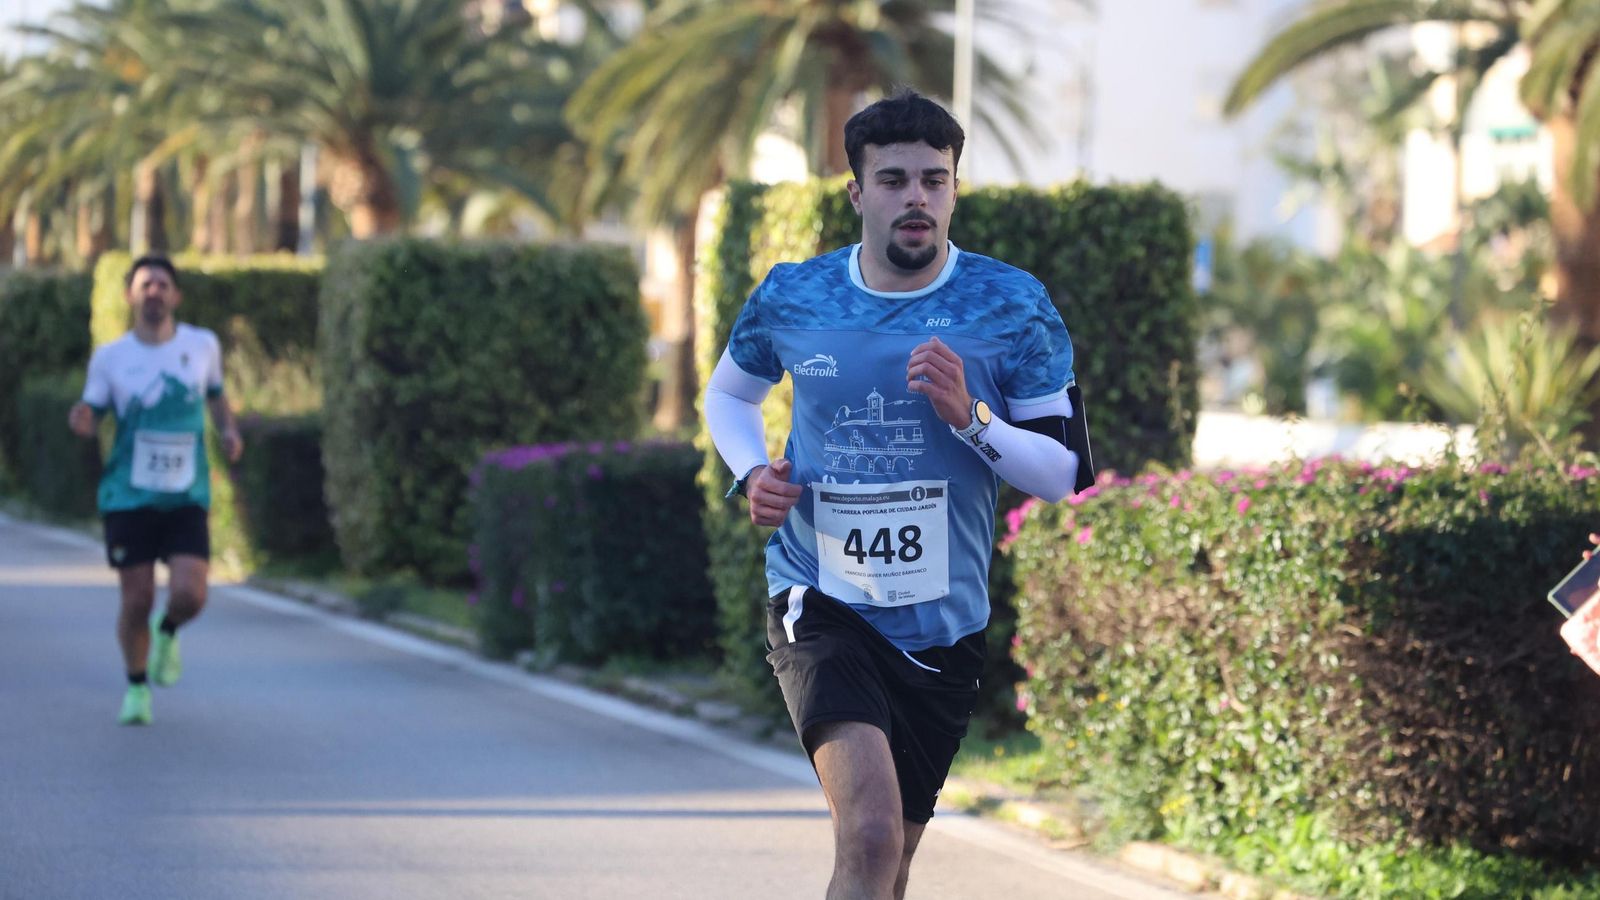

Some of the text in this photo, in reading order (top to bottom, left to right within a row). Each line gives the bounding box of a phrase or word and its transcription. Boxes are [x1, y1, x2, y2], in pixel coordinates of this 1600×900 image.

[794, 363, 839, 377] Electrolit
[896, 505, 917, 513] CIUDAD
[917, 502, 937, 511] JARDÍN
[843, 524, 923, 565] 448
